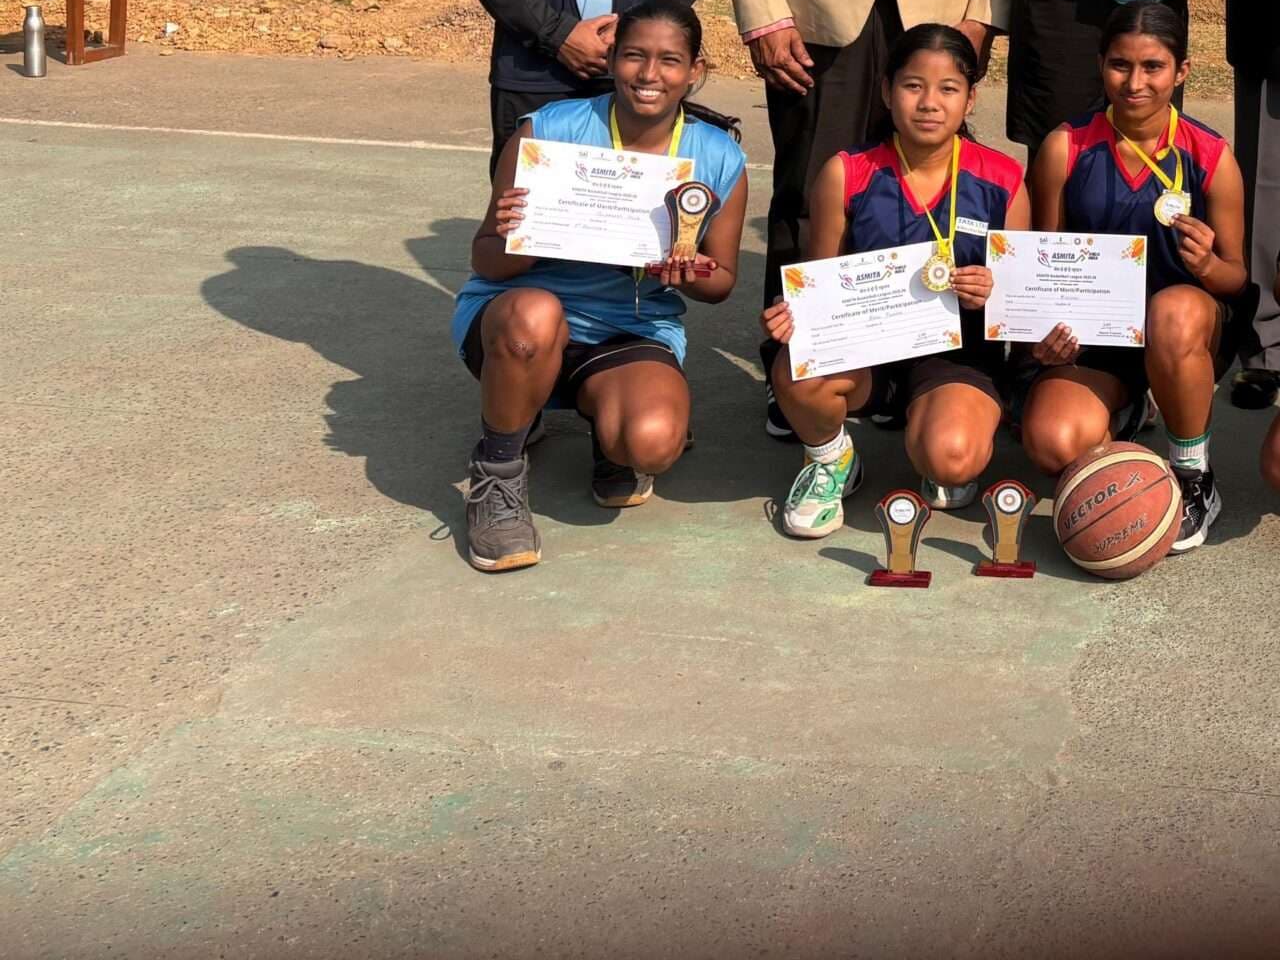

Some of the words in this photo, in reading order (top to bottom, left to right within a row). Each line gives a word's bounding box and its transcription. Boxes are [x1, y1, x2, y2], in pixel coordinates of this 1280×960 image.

[591, 167, 617, 177] ASMITA
[1052, 252, 1076, 260] ASMITA
[856, 271, 881, 282] ASMITA
[1064, 483, 1119, 530] VECTOR
